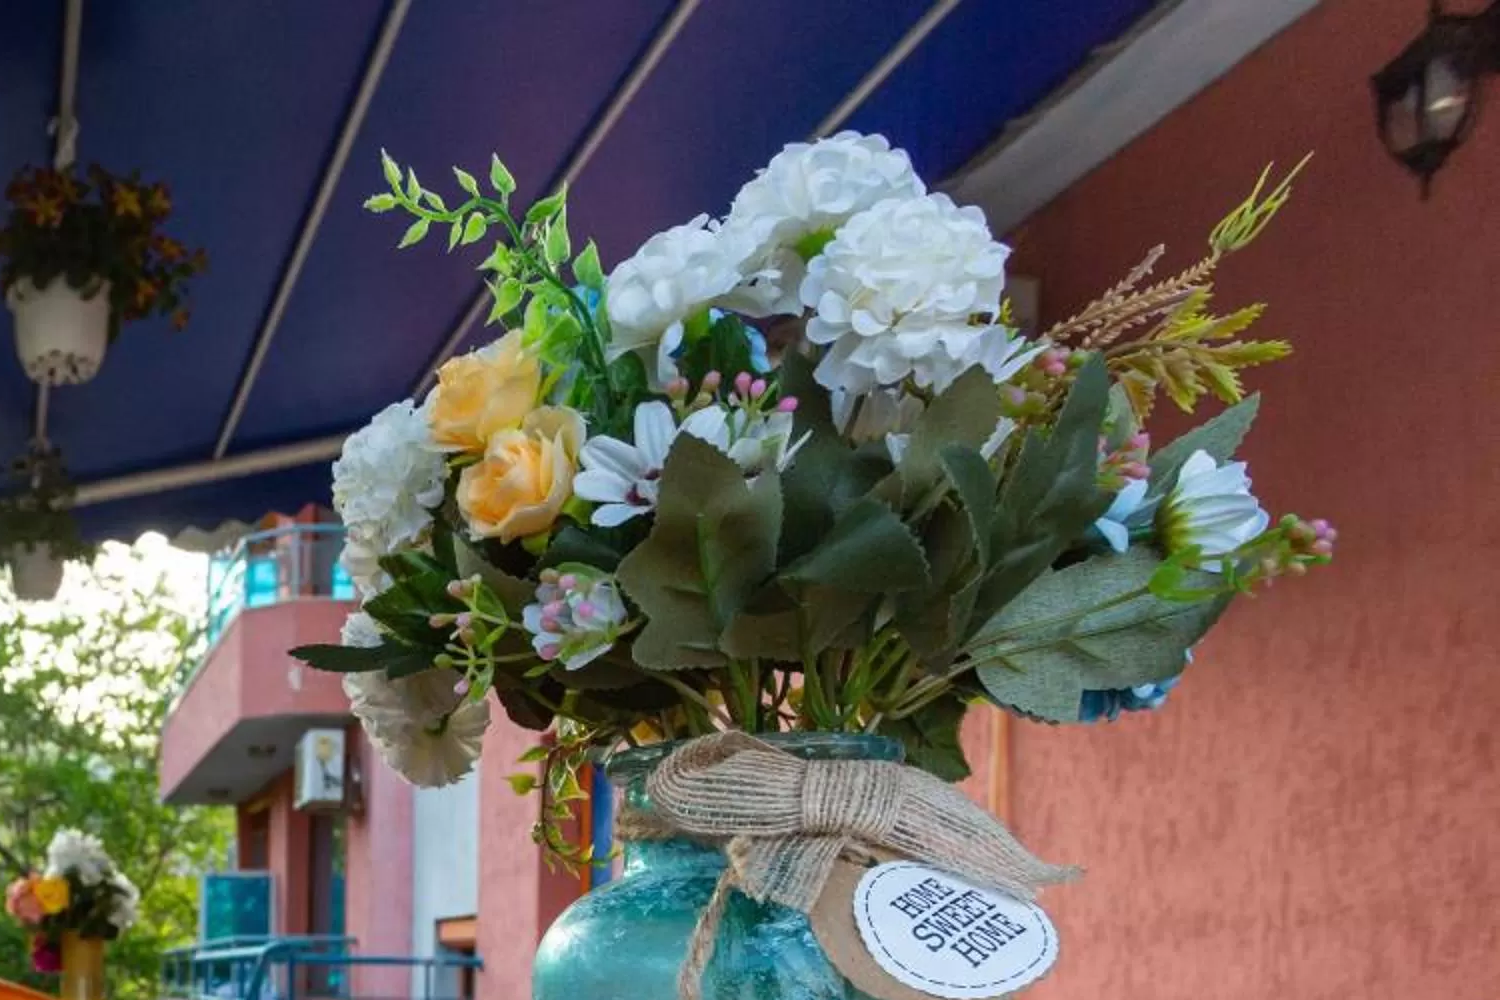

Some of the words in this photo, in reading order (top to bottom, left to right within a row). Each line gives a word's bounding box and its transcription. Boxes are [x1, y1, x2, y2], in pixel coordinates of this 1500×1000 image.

[890, 878, 954, 919] HOME
[913, 890, 996, 952] SWEET
[951, 912, 1026, 967] HOME
